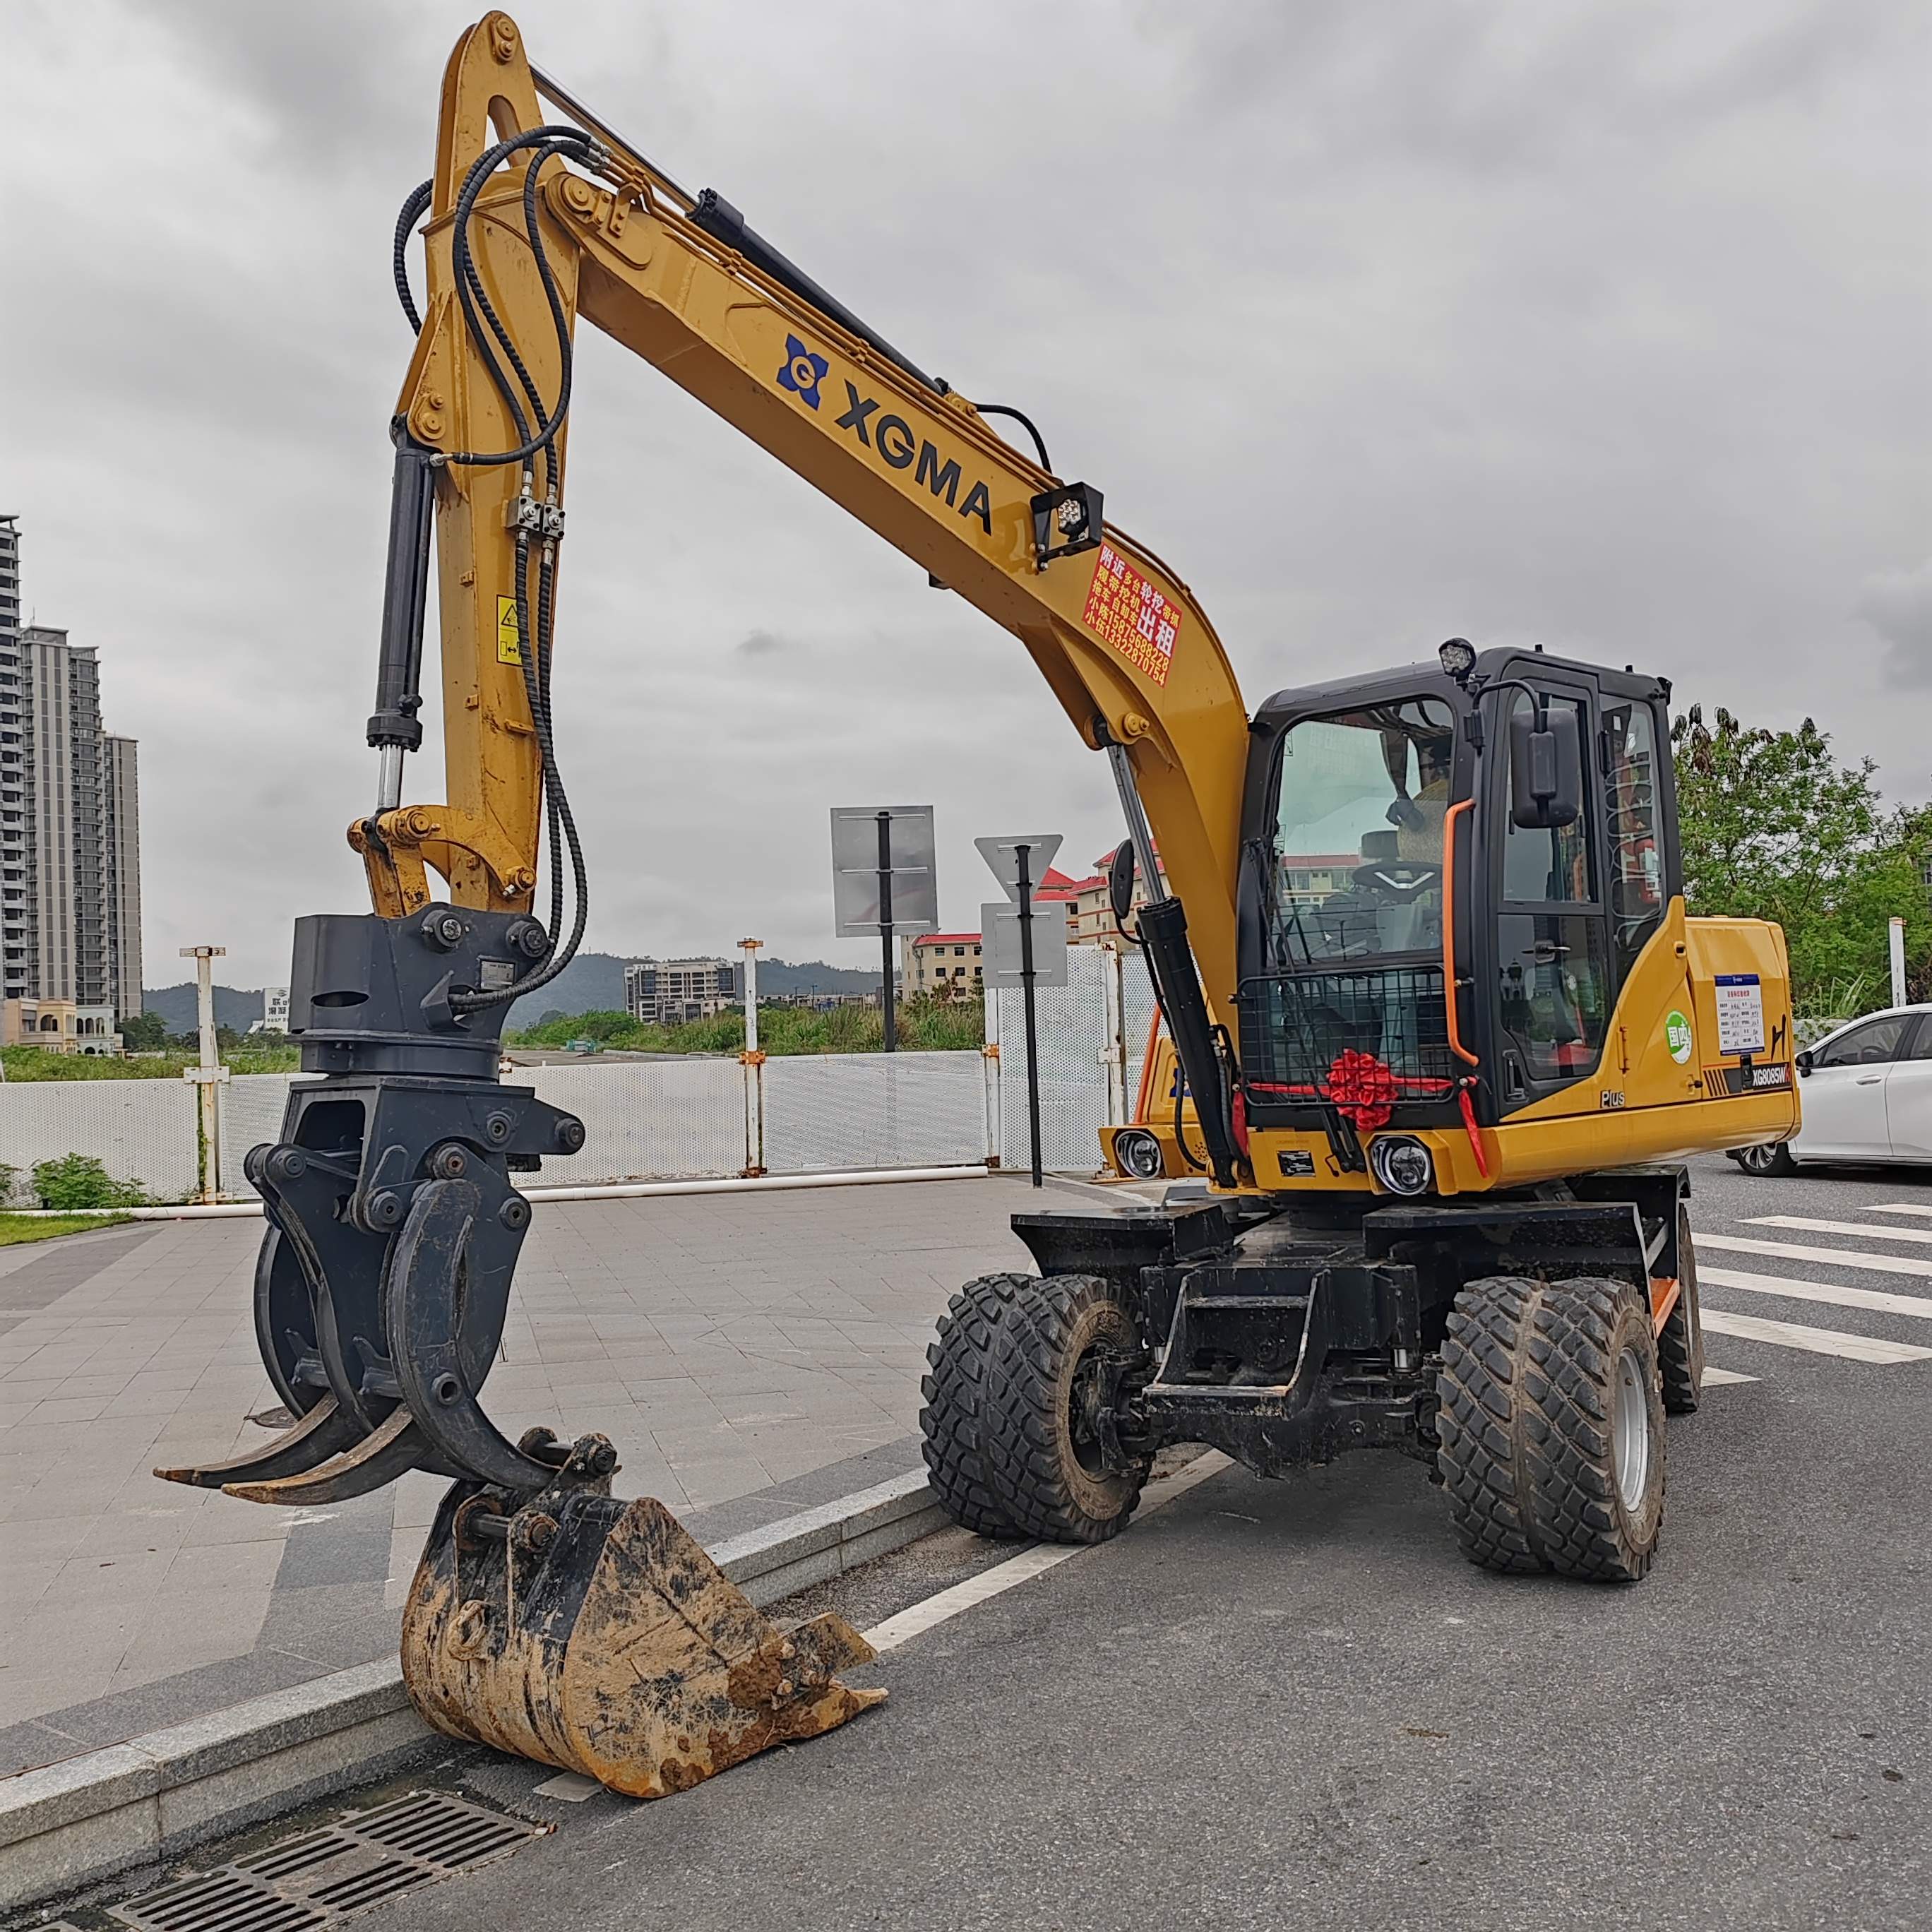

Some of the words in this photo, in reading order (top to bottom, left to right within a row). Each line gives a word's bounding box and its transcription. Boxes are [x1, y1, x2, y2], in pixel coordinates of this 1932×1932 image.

[834, 378, 991, 536] XGMA
[1097, 566, 1140, 612] 履带挖机
[1135, 606, 1176, 657] 出租
[1601, 1090, 1625, 1108] Plus
